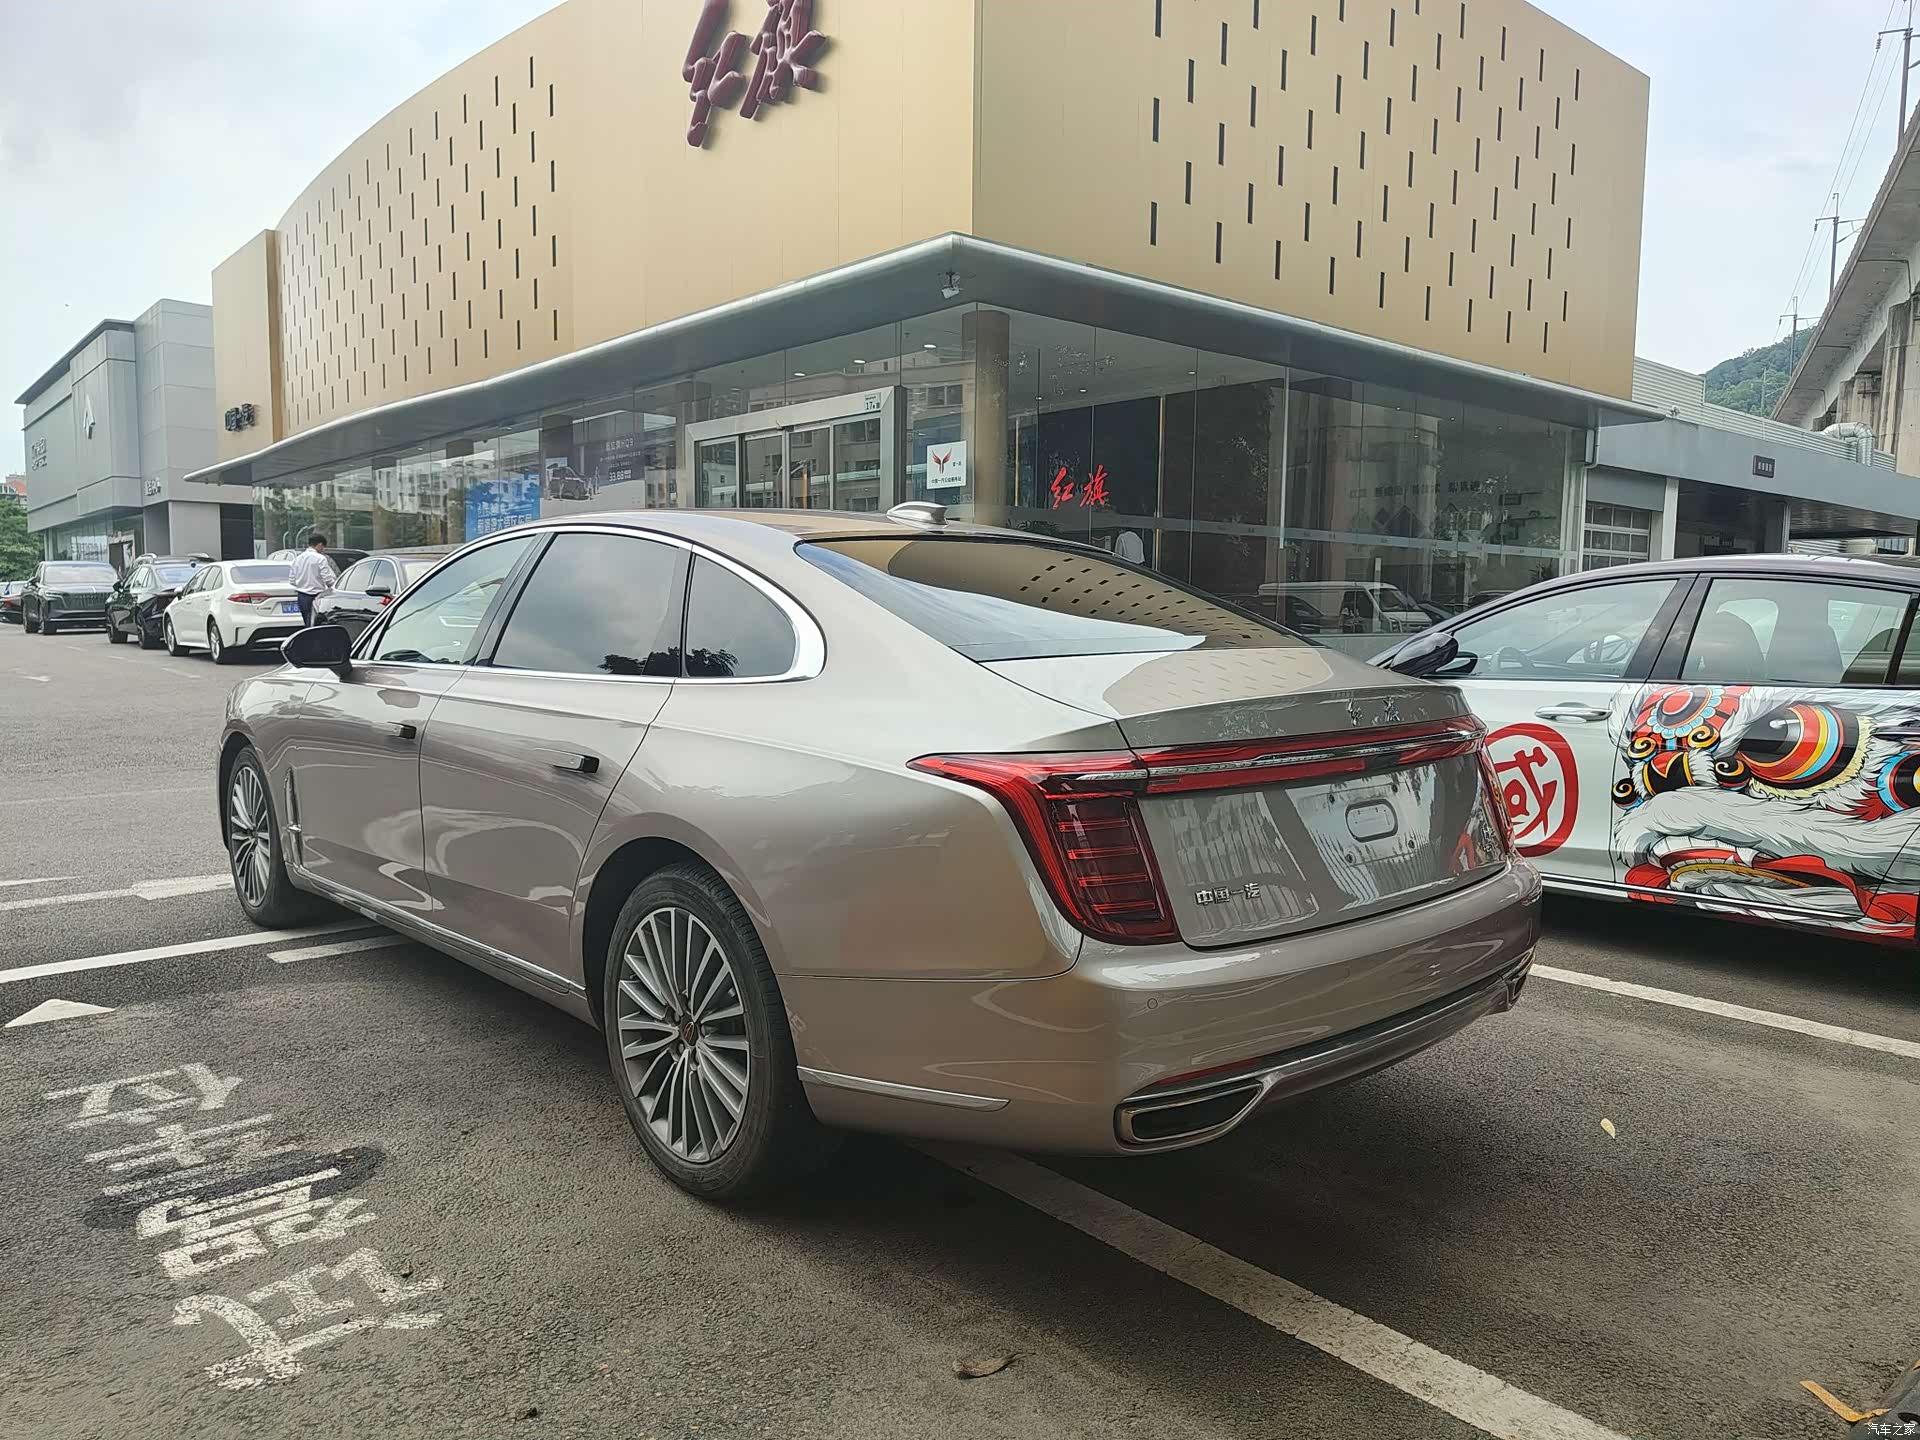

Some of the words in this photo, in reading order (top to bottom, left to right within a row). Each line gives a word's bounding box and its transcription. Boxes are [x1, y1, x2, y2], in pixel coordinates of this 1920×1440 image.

[1051, 464, 1109, 510] 红旗
[1195, 882, 1260, 905] 中国一汽
